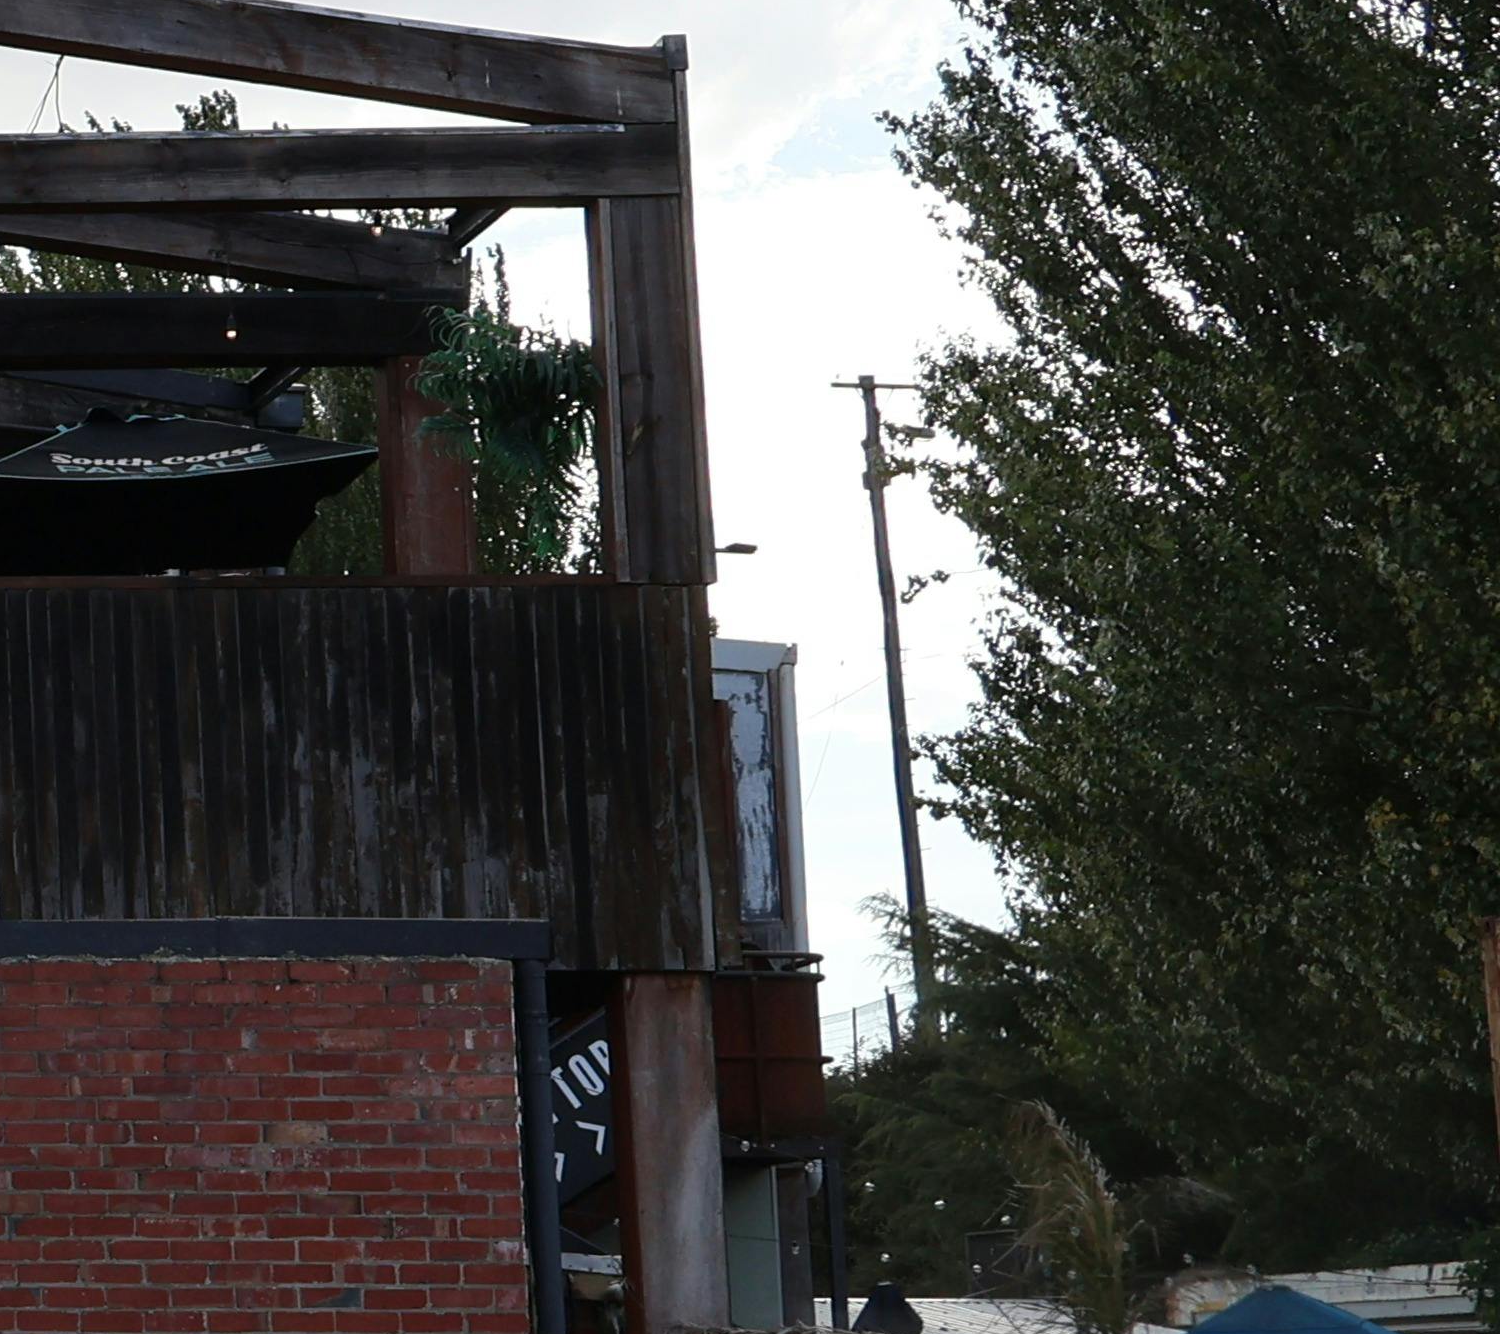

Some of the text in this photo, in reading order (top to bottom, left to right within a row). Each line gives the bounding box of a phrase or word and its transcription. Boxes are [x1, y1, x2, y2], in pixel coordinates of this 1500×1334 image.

[48, 443, 269, 467] South Coast
[185, 452, 276, 473] ALE
